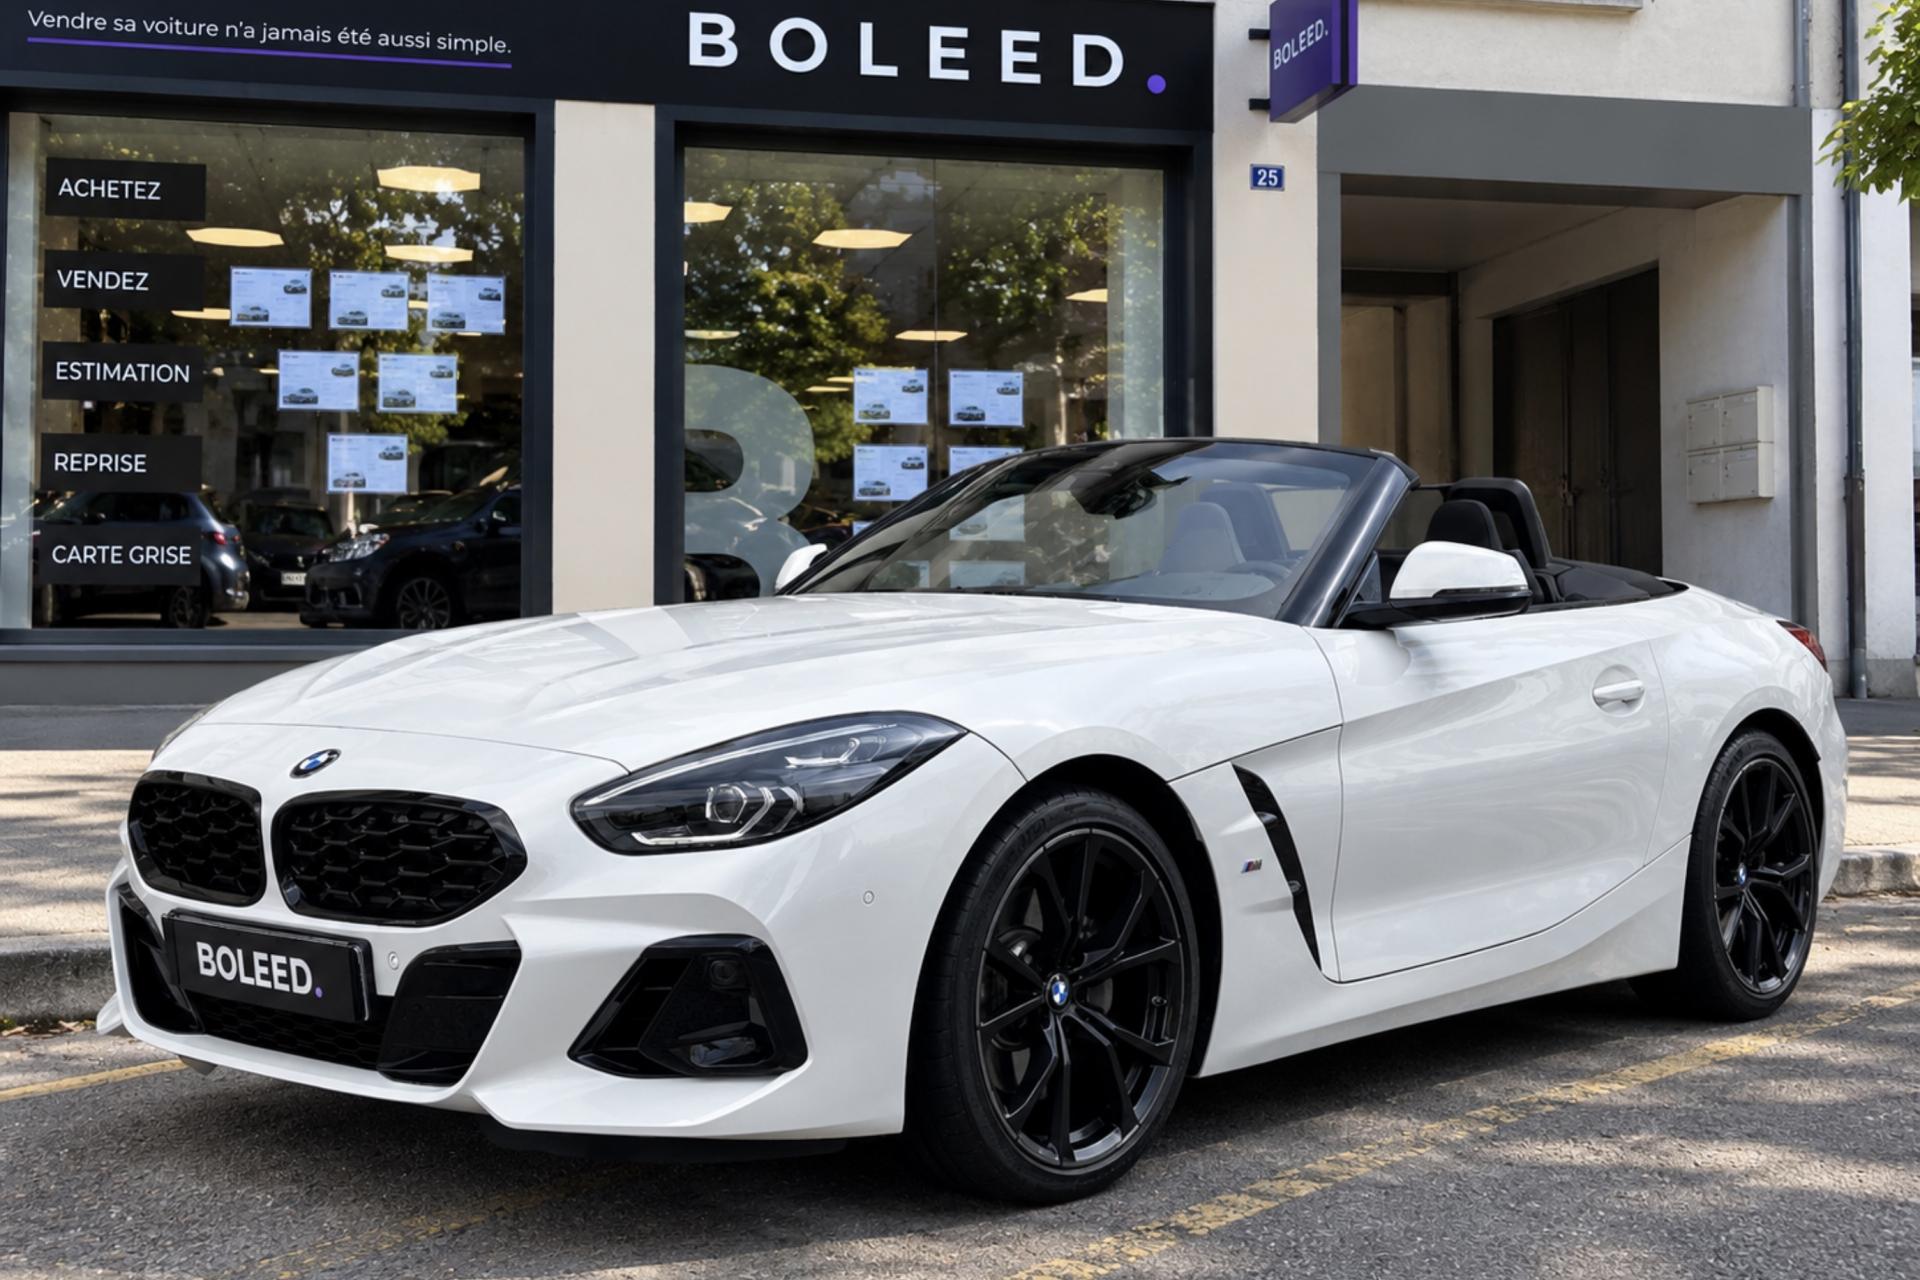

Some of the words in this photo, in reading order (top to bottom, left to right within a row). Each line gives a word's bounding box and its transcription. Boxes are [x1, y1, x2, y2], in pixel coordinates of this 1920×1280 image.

[27, 9, 107, 31] Vendre
[113, 18, 136, 32] sa
[142, 17, 219, 37] voiture
[225, 22, 255, 39] n'a
[260, 22, 332, 44] jamais
[337, 26, 372, 46] été
[377, 32, 430, 49] aussi
[436, 34, 512, 56] simple.
[689, 11, 1167, 94] BOLEED.
[1273, 19, 1329, 70] BOLEED.
[1257, 168, 1279, 187] 25
[58, 178, 161, 201] ACHETEZ
[57, 270, 149, 291] VENDEZ
[56, 362, 190, 382] ESTIMATION
[54, 453, 147, 473] REPRISE
[52, 545, 123, 564] CARTE
[129, 545, 192, 565] GRISE
[196, 941, 323, 998] BOLEED.
